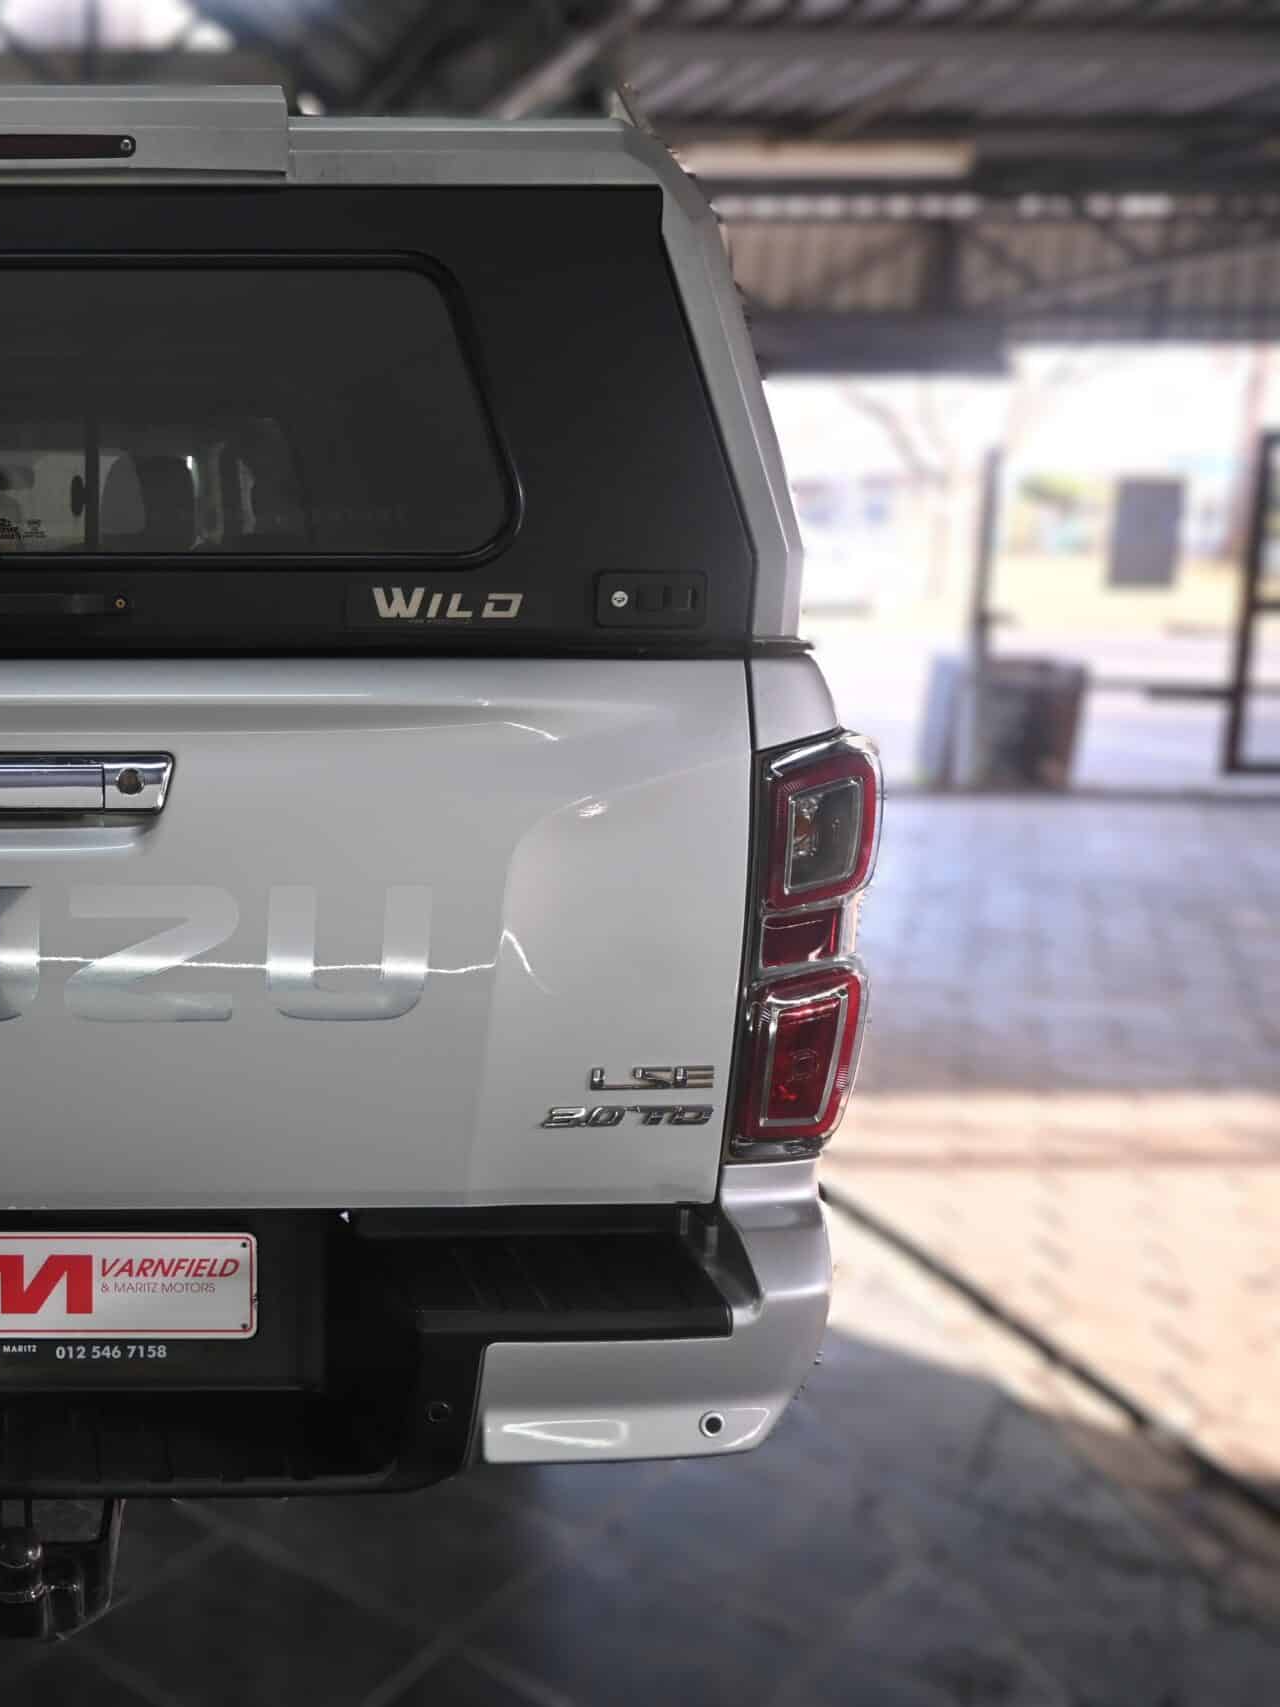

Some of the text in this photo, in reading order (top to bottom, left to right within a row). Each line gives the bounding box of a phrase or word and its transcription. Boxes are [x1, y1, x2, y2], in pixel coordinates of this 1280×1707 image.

[372, 587, 523, 618] WILD
[590, 1065, 715, 1090] LSE
[100, 1258, 240, 1278] VARNFIELD
[101, 1281, 216, 1293] & MARITZ MOTORS
[3, 1344, 37, 1353] MARITZ
[56, 1345, 167, 1359] 012 546 7158
